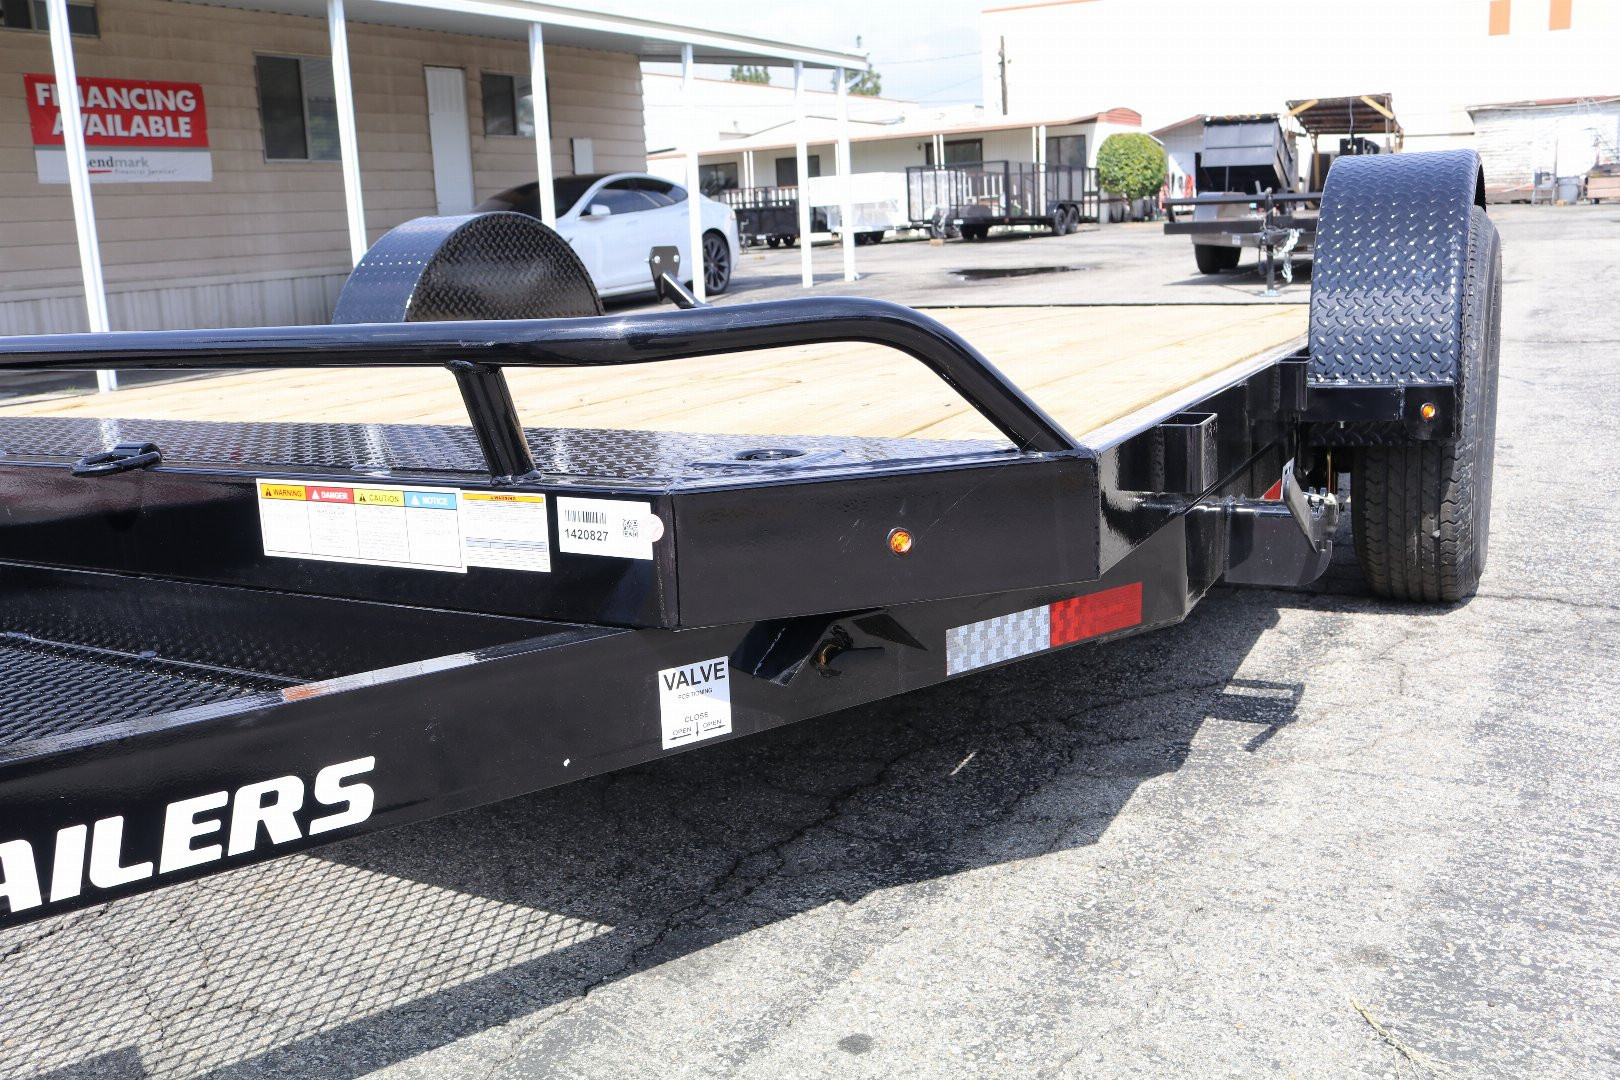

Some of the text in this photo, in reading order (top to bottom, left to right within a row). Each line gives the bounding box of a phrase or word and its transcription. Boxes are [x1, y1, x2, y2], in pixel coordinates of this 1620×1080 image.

[87, 156, 149, 168] endmark
[273, 488, 302, 497] WARNING
[320, 491, 349, 500] DANGER
[369, 494, 399, 503] CAUTION
[422, 496, 449, 506] NOTICE
[564, 528, 609, 542] 1420827
[663, 661, 726, 691] VALVE
[678, 687, 713, 700] POSTIONING
[684, 712, 709, 723] CLOSE
[702, 719, 722, 728] OPEN
[672, 726, 692, 736] OPEN
